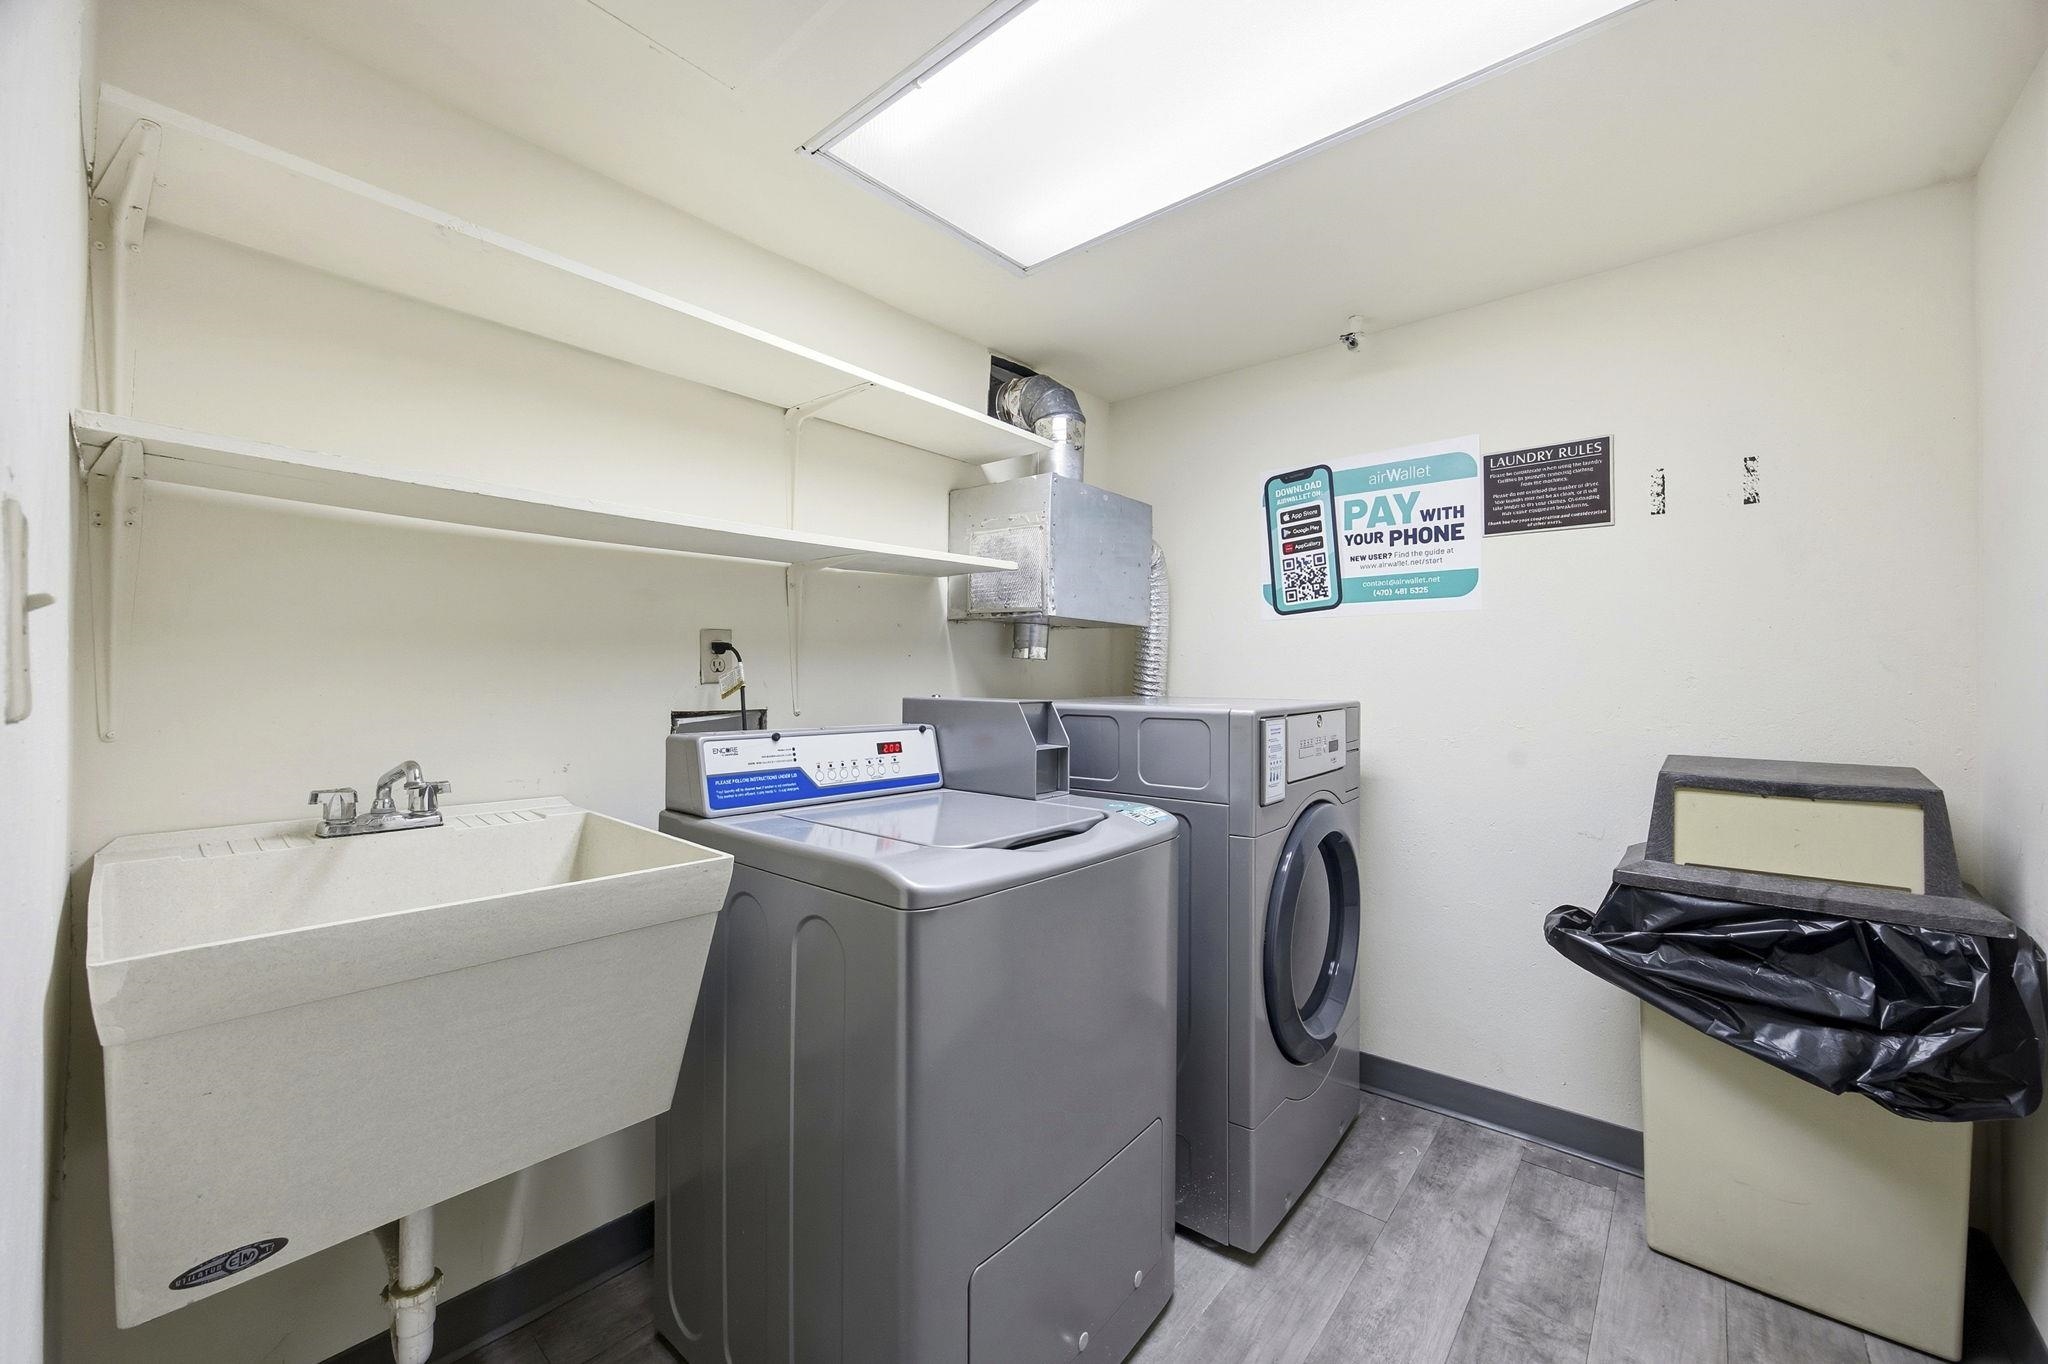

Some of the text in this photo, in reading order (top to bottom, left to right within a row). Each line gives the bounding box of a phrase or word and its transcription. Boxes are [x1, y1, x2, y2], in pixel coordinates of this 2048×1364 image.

[1490, 442, 1602, 468] LAUNDRY RULES
[1368, 464, 1432, 485] airWallet
[1275, 480, 1322, 497] DOWNLOAD
[1277, 492, 1311, 505] AIRWALLET
[1344, 490, 1465, 531] PAY WITH
[1292, 526, 1309, 534] Google
[1344, 522, 1465, 547] YOUR PHONE
[1295, 540, 1321, 550] AppGallery
[1368, 552, 1393, 561] USER?
[1424, 548, 1445, 558] guide
[1360, 557, 1443, 570] www.airwallet.net/start
[1362, 575, 1441, 588] contact@airwallet.net
[715, 778, 732, 786] PLEASE
[732, 776, 750, 784] FOLLOW
[749, 774, 778, 783] INSTRUCTIONS
[778, 772, 791, 780] UNDER
